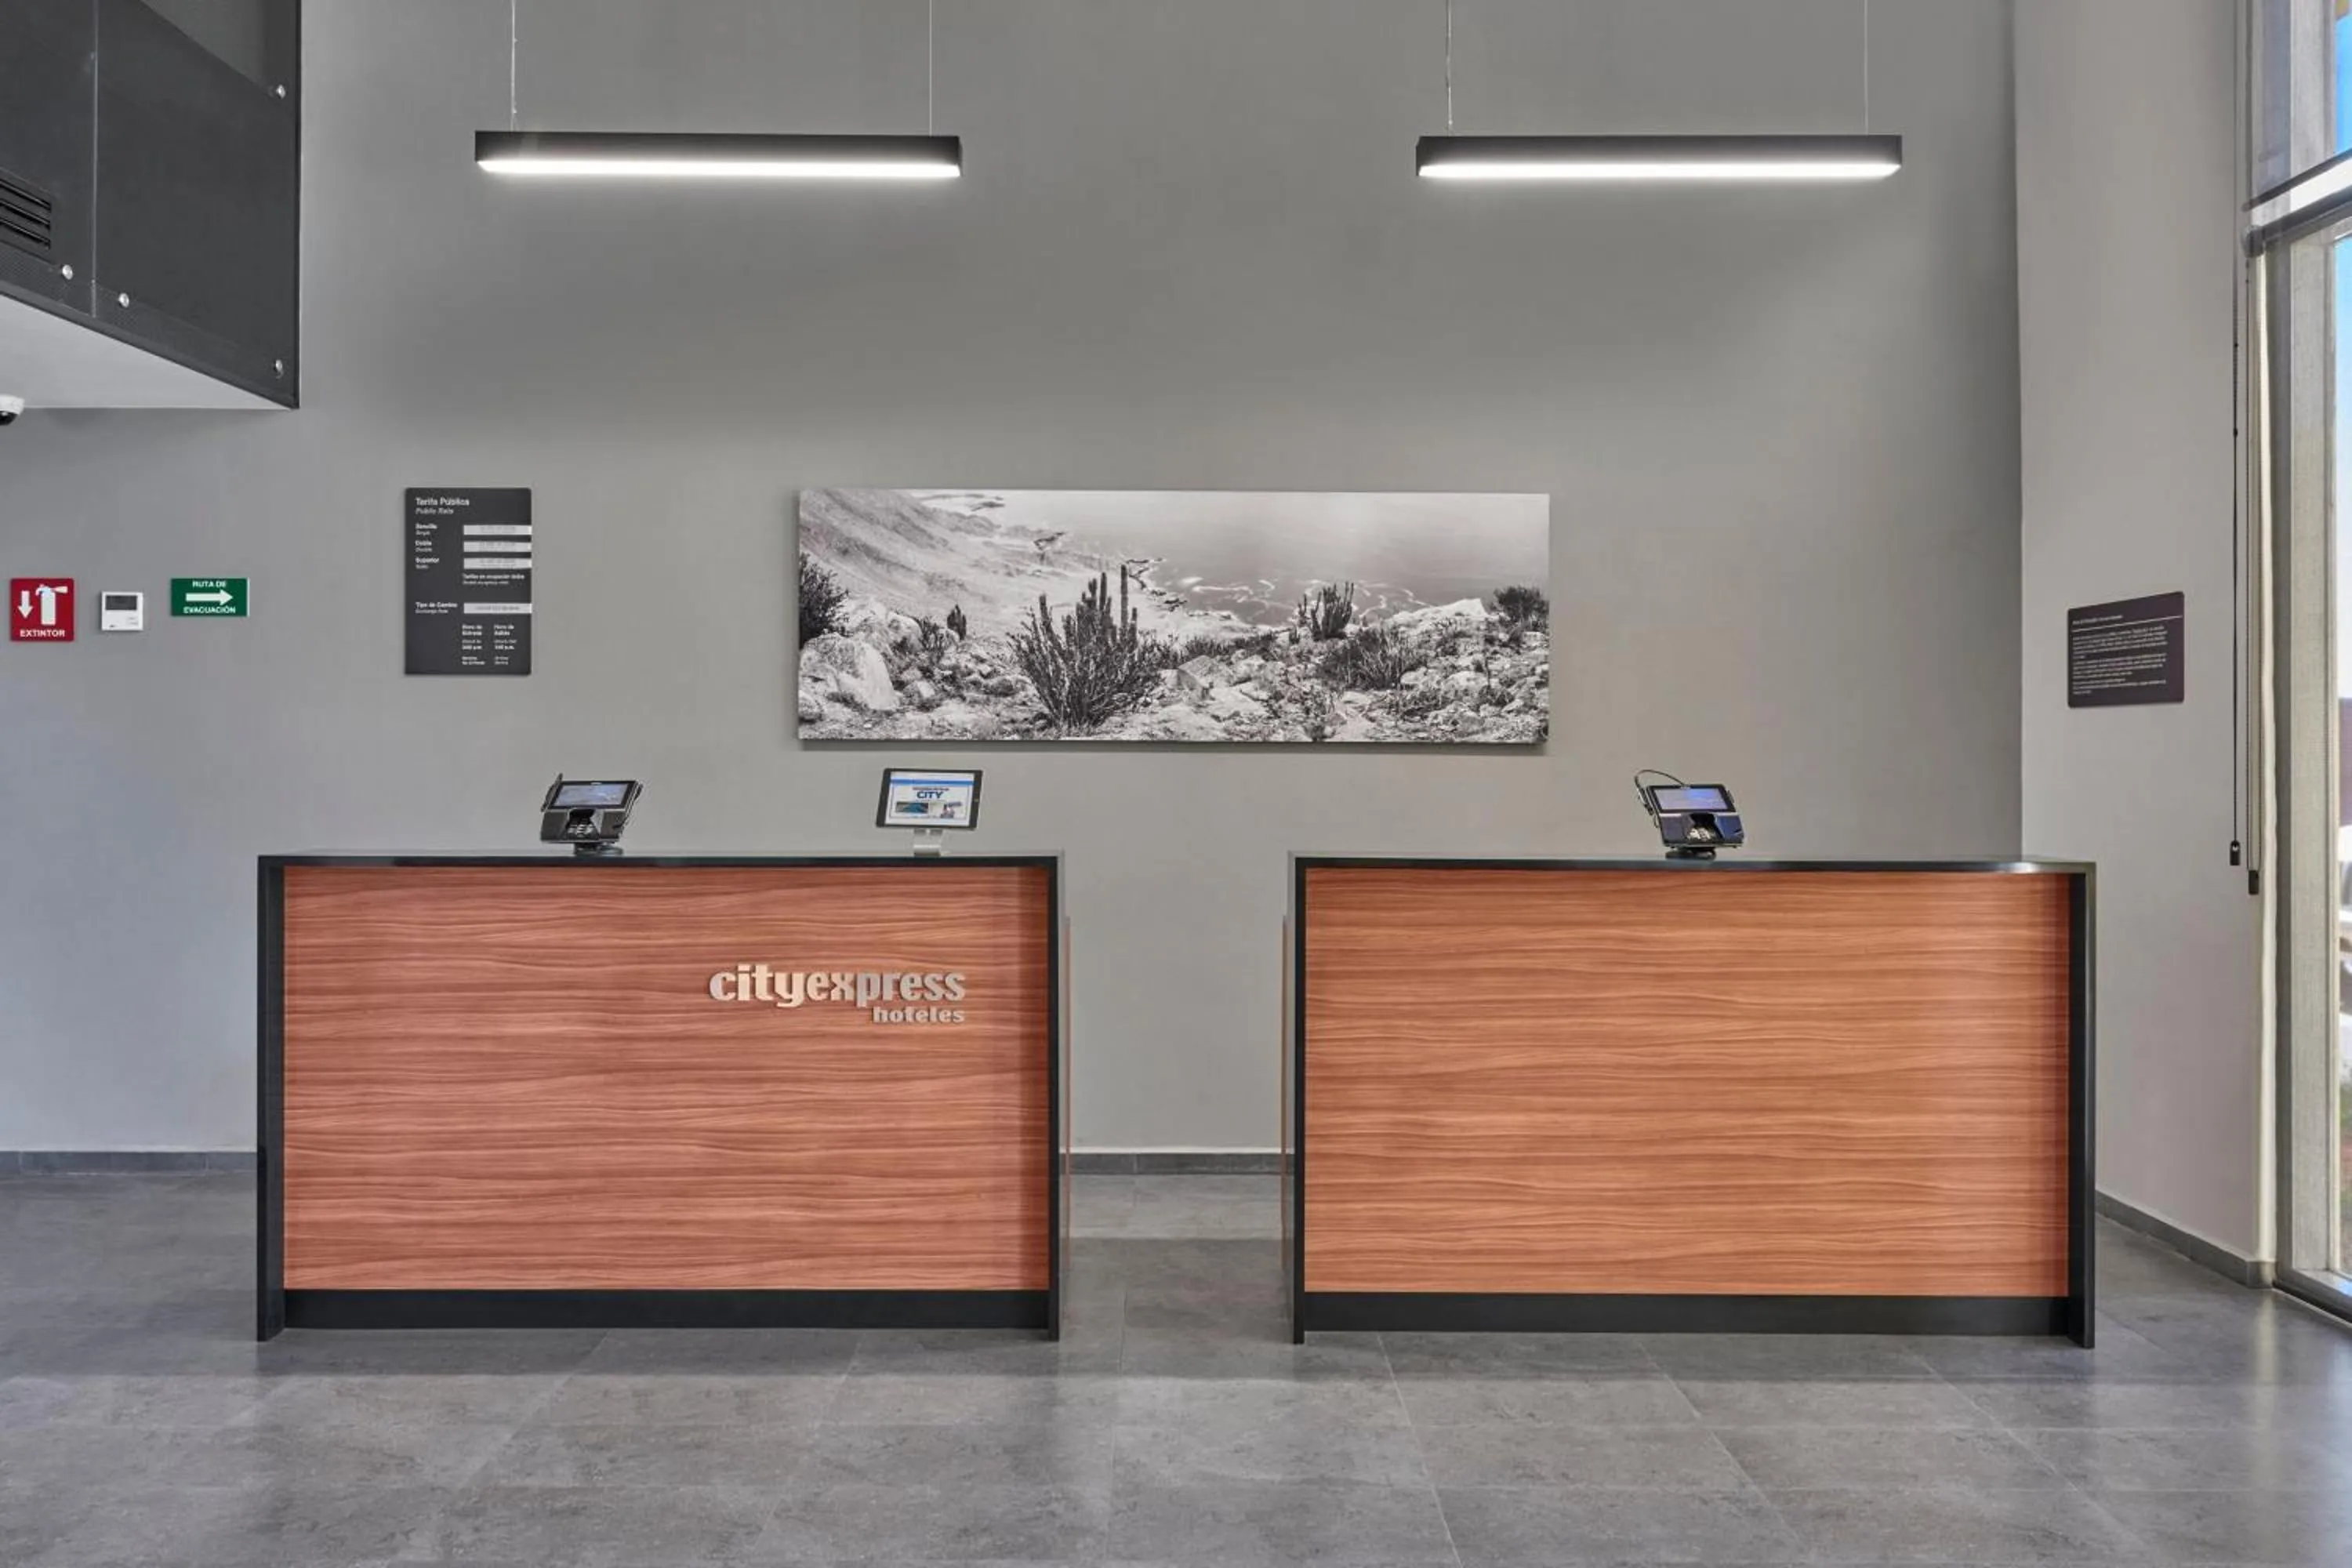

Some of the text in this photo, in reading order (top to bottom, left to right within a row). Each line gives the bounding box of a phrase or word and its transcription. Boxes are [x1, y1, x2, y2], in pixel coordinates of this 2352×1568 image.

[183, 604, 236, 614] EVACUACIÓN
[20, 629, 65, 637] EXTINTOR
[873, 1006, 966, 1023] hoteles
